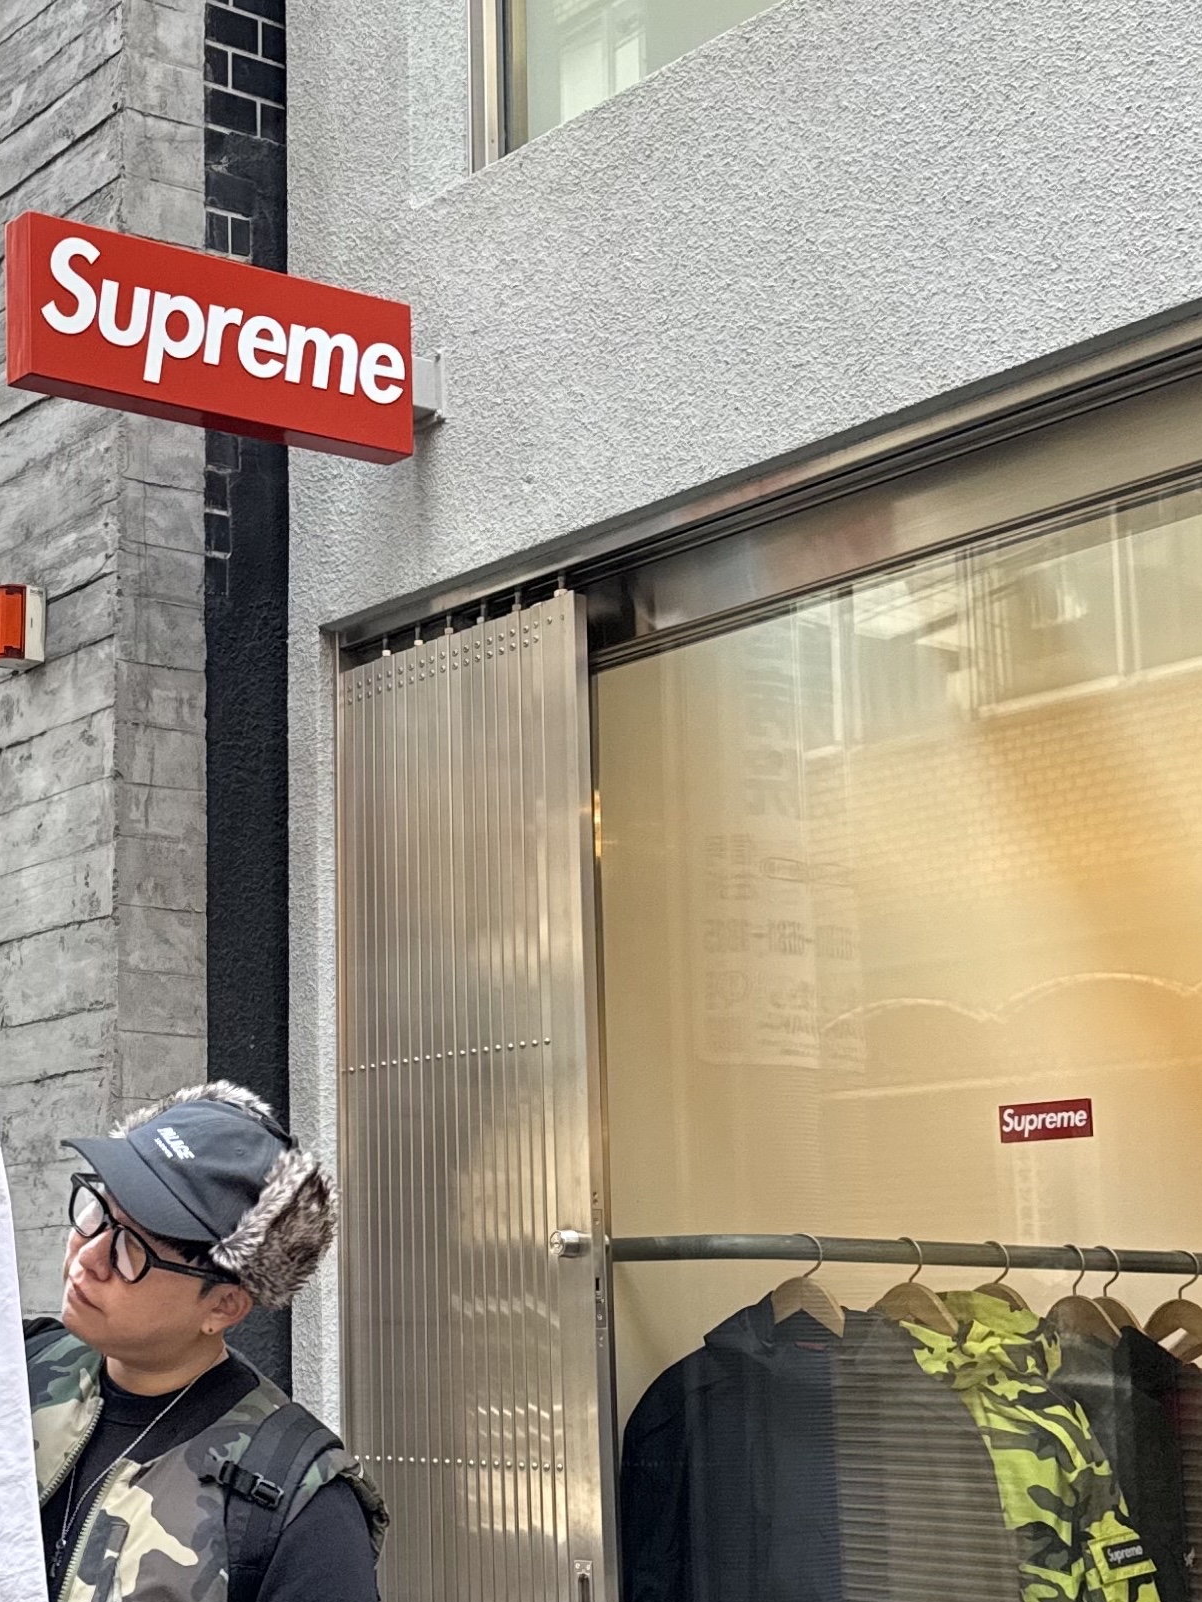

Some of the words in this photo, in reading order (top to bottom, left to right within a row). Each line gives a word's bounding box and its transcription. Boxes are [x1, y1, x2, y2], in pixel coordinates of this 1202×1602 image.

[40, 236, 406, 406] Supreme
[1001, 1107, 1088, 1139] Supreme
[1106, 1544, 1144, 1565] Supreme
